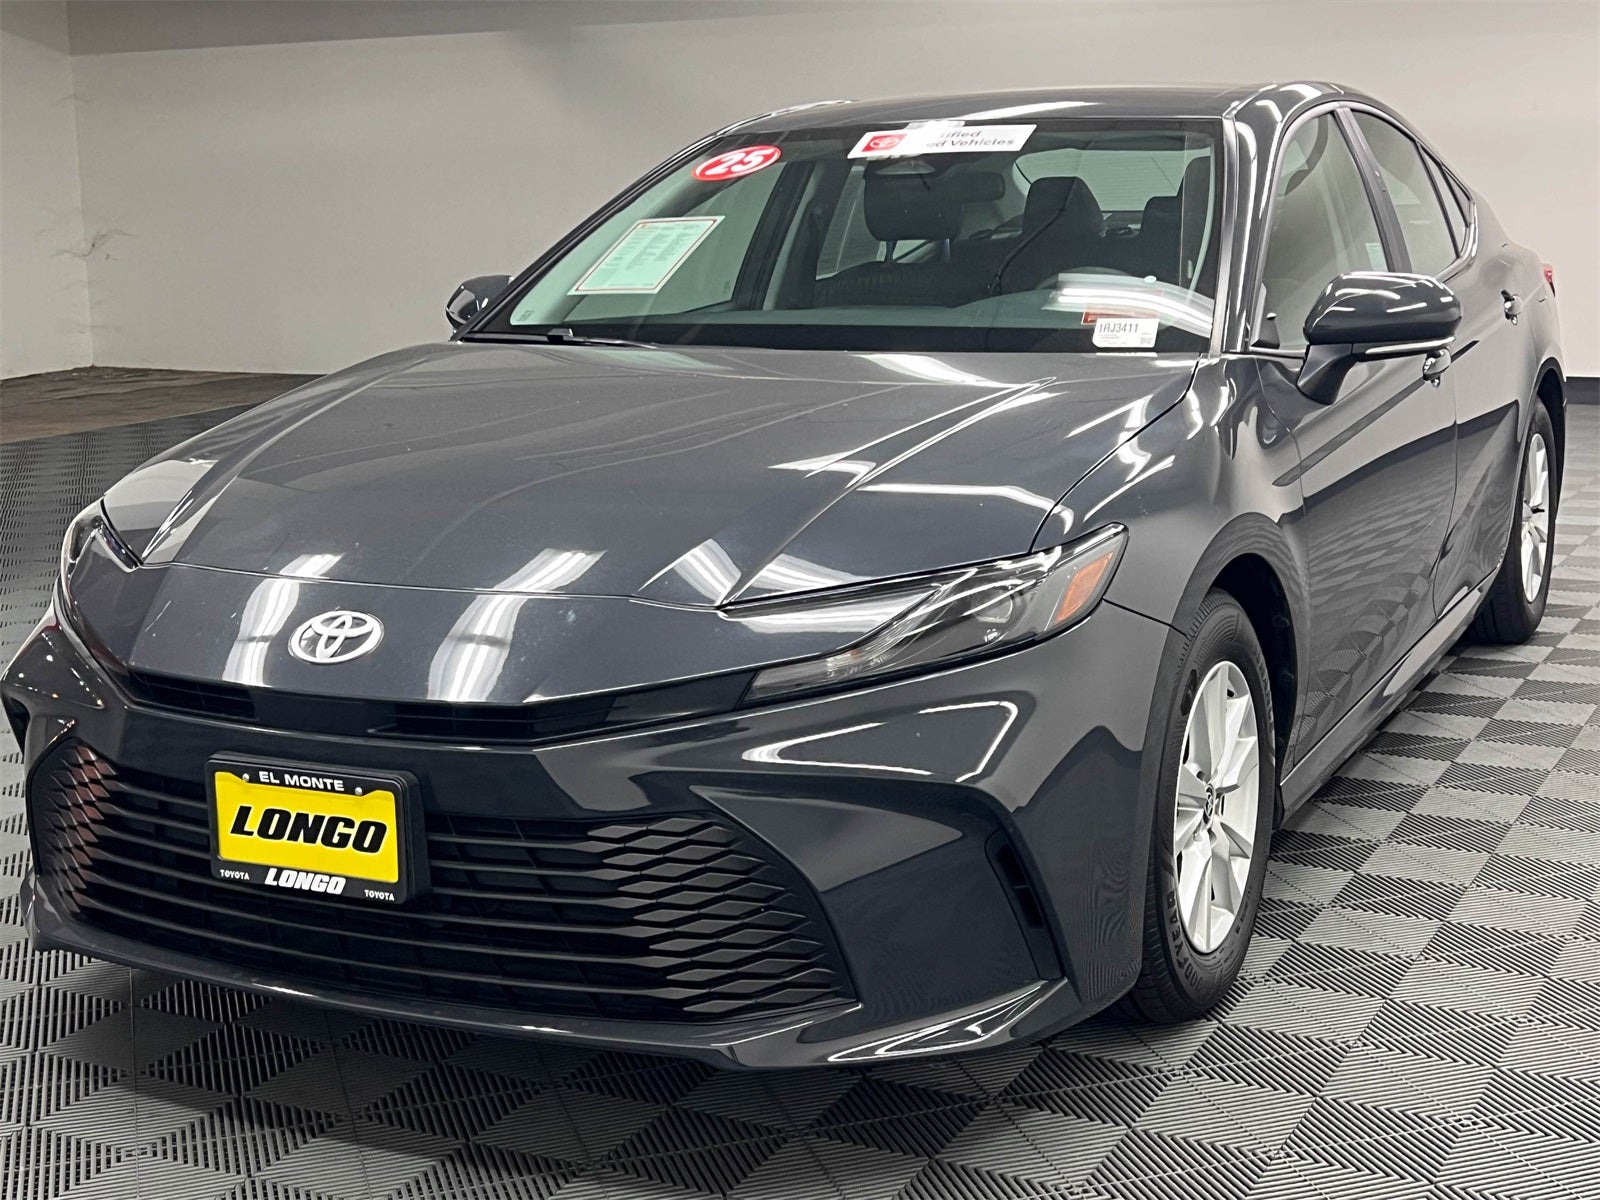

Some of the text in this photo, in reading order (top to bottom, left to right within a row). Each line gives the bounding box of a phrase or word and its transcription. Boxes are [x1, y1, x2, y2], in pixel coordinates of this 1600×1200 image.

[951, 138, 1015, 147] Vehicles
[704, 148, 776, 176] 25
[258, 770, 345, 792] EL MONTE
[230, 805, 388, 854] LONGO
[219, 867, 395, 902] TOYOTA LONGO TOYOTA
